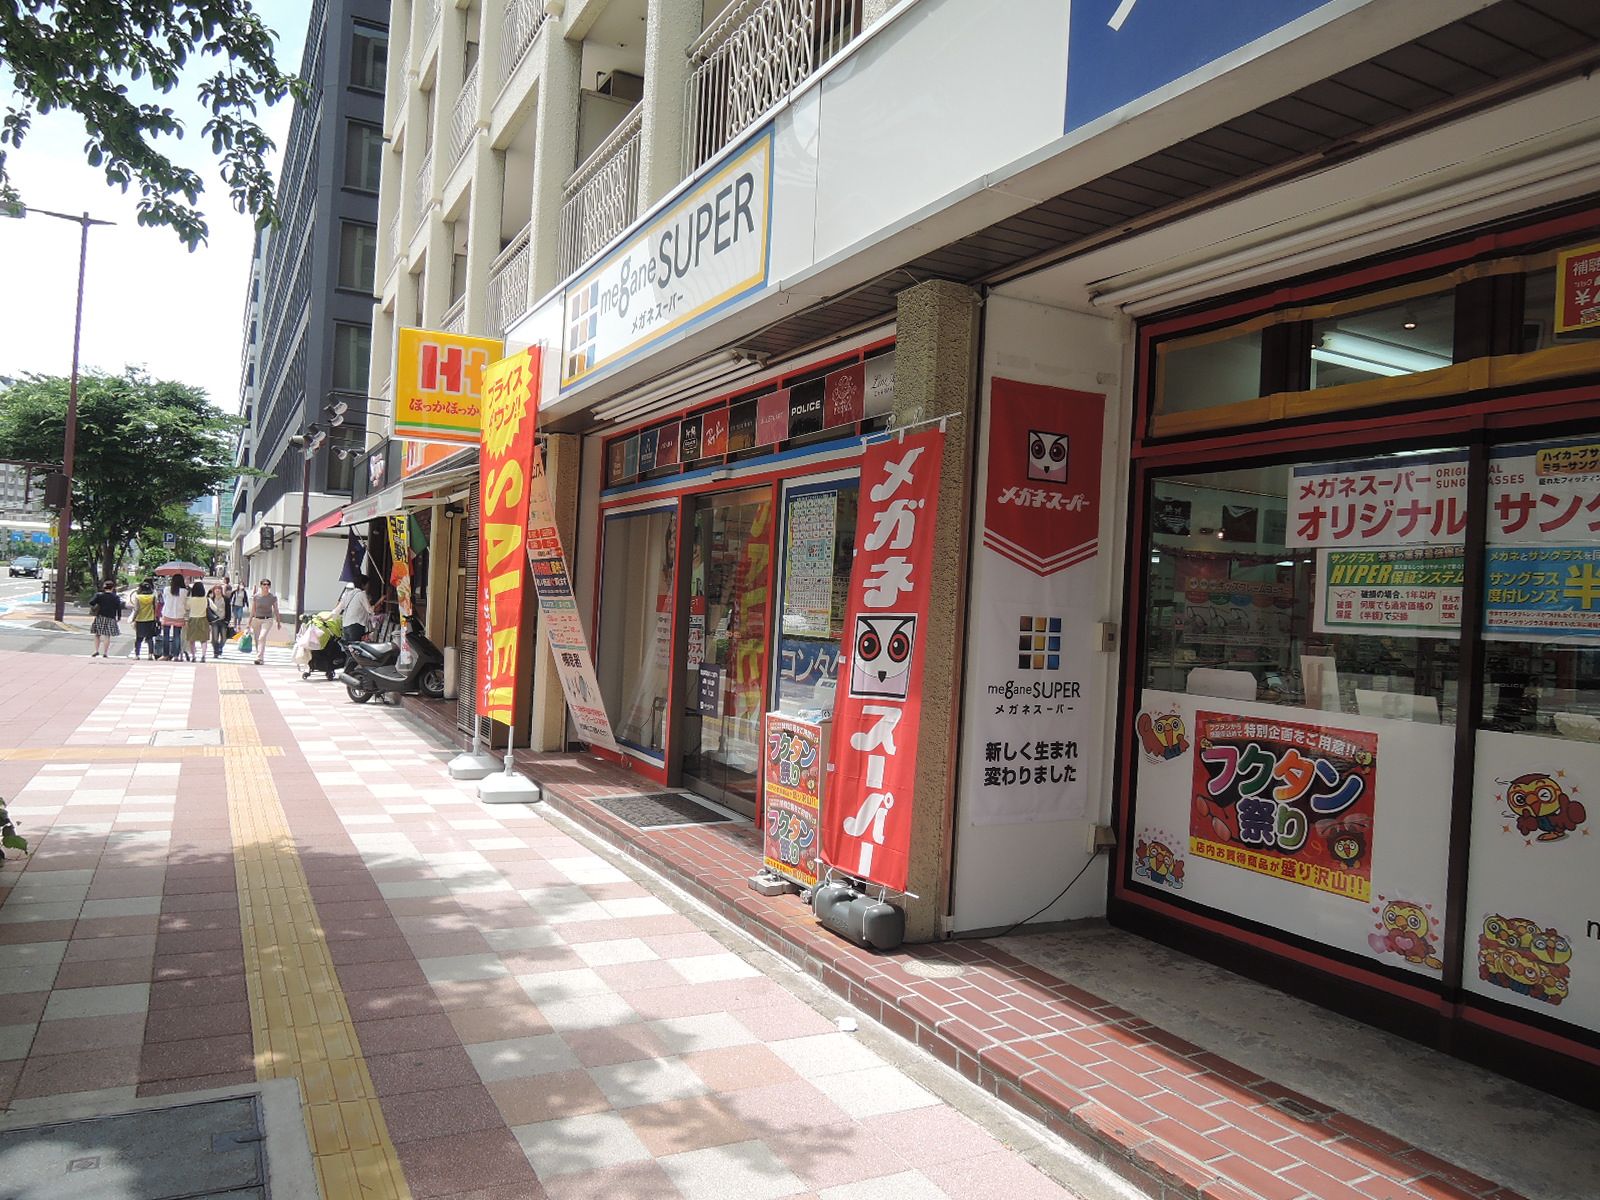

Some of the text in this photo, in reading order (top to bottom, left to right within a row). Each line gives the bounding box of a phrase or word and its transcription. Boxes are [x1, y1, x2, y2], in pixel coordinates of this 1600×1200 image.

[632, 292, 684, 334] メガネスーパー
[791, 400, 821, 416] POLICE
[998, 486, 1090, 513] メガネスーパー
[1299, 471, 1432, 500] メガネスーパー
[1296, 497, 1467, 541] オリジナル
[1330, 564, 1392, 584] HYPER
[1489, 571, 1560, 587] サングラス
[843, 446, 925, 876] メガネ スーパー
[995, 704, 1074, 715] メガネスーパー
[769, 733, 816, 768] フクタン
[985, 740, 1078, 763] 新しく生まれ
[780, 759, 800, 786] 祭り
[984, 764, 1077, 786] 変わりました
[1201, 743, 1364, 814] フクタン
[769, 810, 815, 848] フクタン
[1236, 796, 1308, 850] 祭り
[780, 837, 800, 865] 祭り
